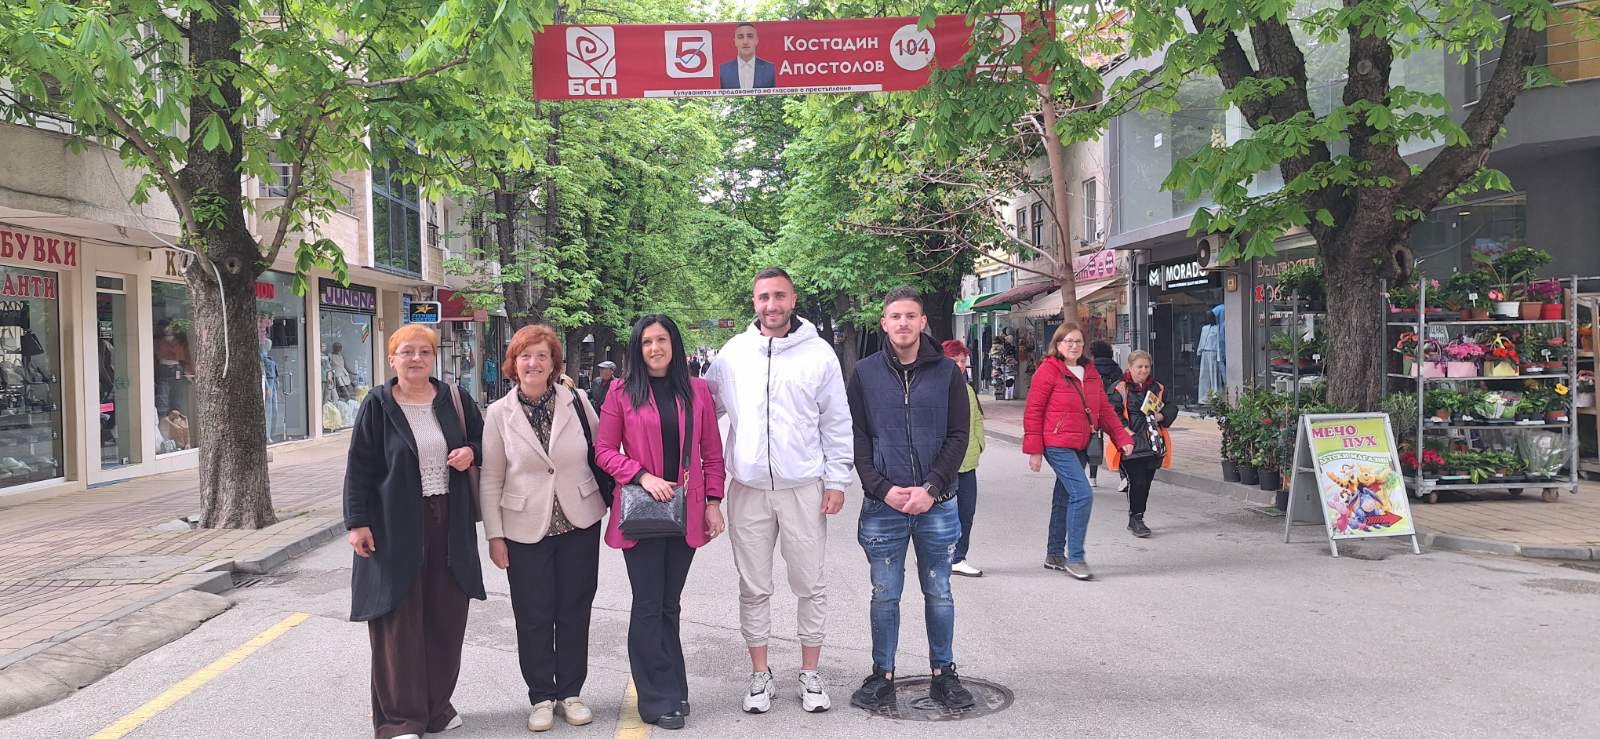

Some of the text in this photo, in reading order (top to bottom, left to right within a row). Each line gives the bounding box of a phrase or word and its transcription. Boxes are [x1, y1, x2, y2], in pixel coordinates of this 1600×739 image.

[783, 35, 879, 51] Костадин
[895, 38, 930, 56] 104
[674, 36, 707, 74] 5
[779, 60, 884, 75] Апостолов
[568, 78, 617, 96] БСП
[0, 230, 77, 266] БУВКИ
[325, 286, 376, 309] JUNONA
[1312, 425, 1356, 438] МЕЧО
[1343, 435, 1377, 448] ПУХ
